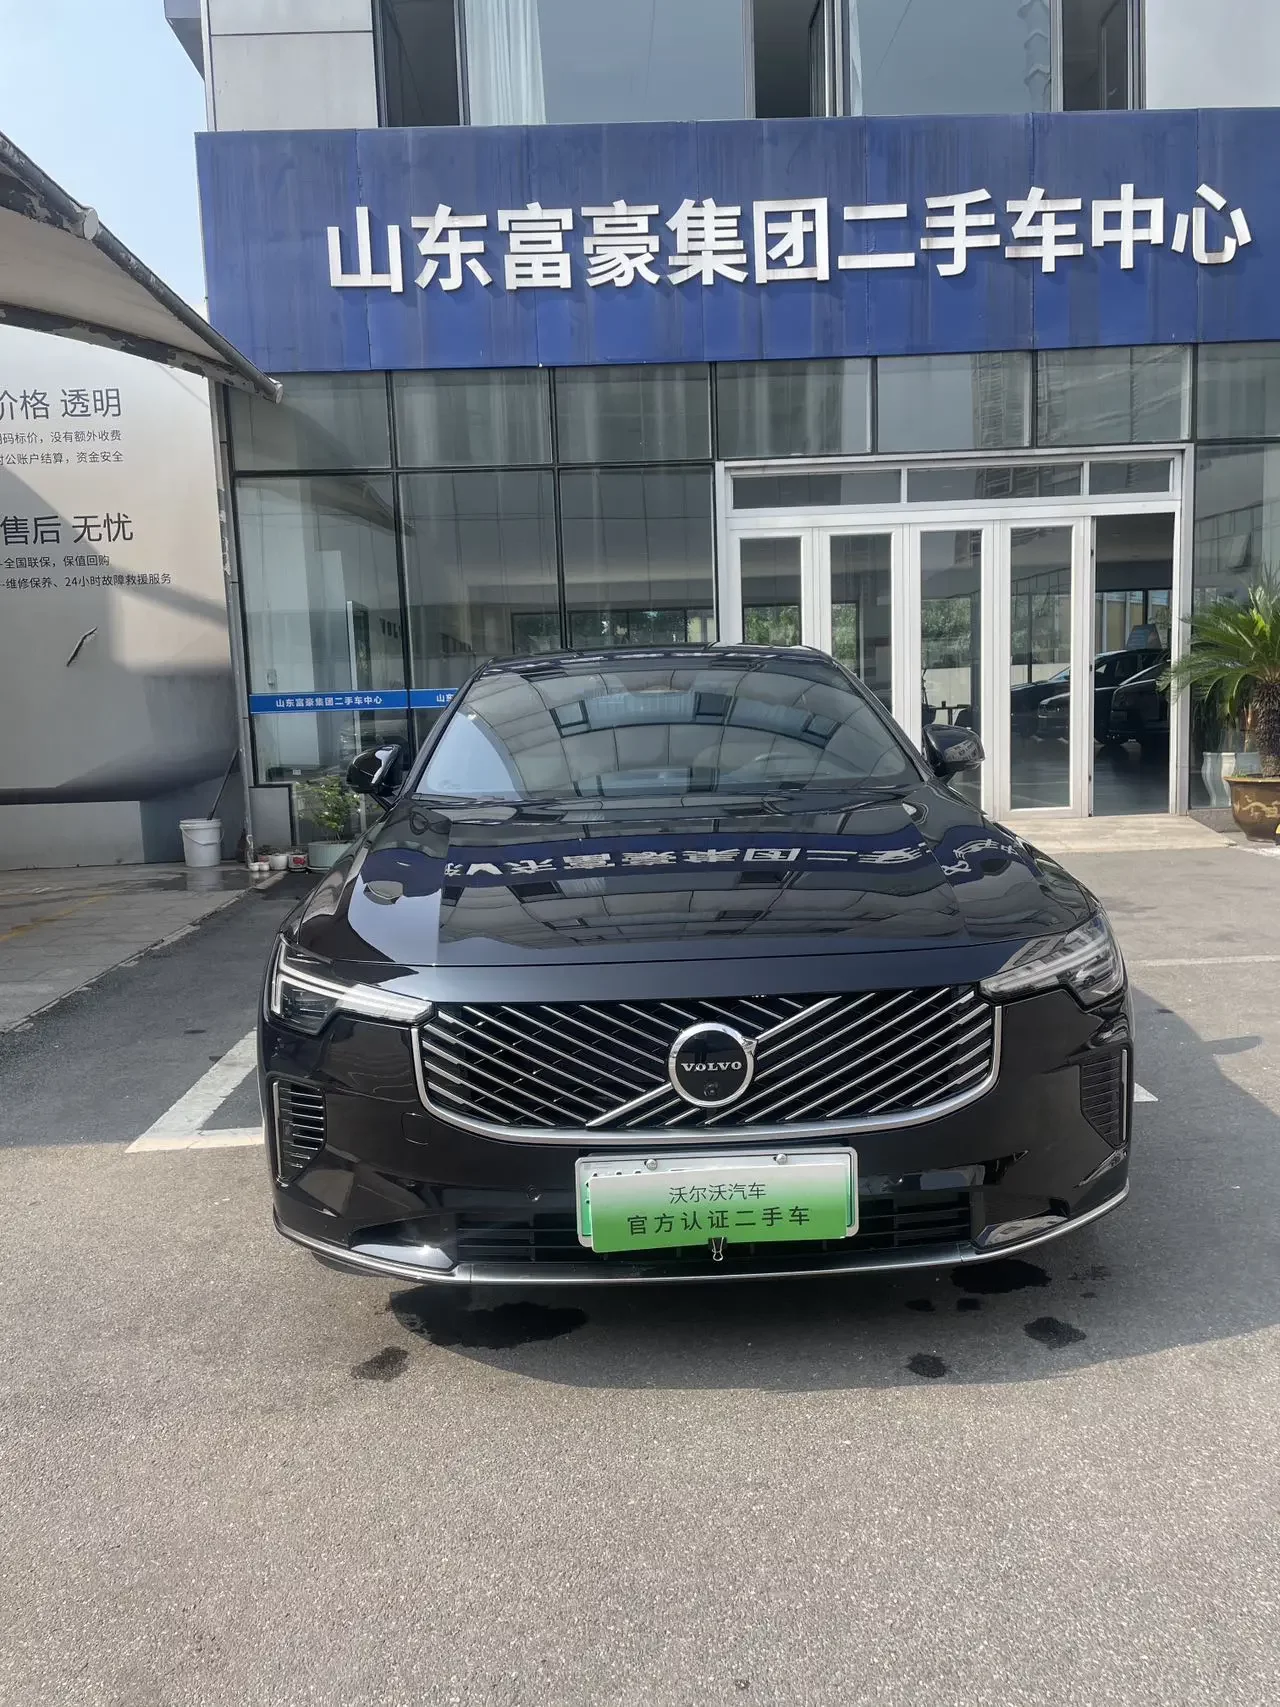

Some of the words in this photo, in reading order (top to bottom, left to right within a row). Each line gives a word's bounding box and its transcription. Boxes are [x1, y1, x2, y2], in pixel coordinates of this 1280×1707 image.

[326, 183, 1252, 293] 山东富豪集团二手车中心
[0, 389, 50, 420] 价格
[60, 388, 122, 418] 透明
[0, 429, 122, 445] 码标价，没有额外收费
[0, 515, 61, 546] 售后
[72, 512, 134, 544] 无忧
[275, 695, 383, 708] 山东富豪集团二手车中心
[681, 1061, 742, 1072] VOLVO
[669, 1182, 767, 1204] 沃尔沃汽车
[627, 1206, 811, 1236] 官方认证二手车
